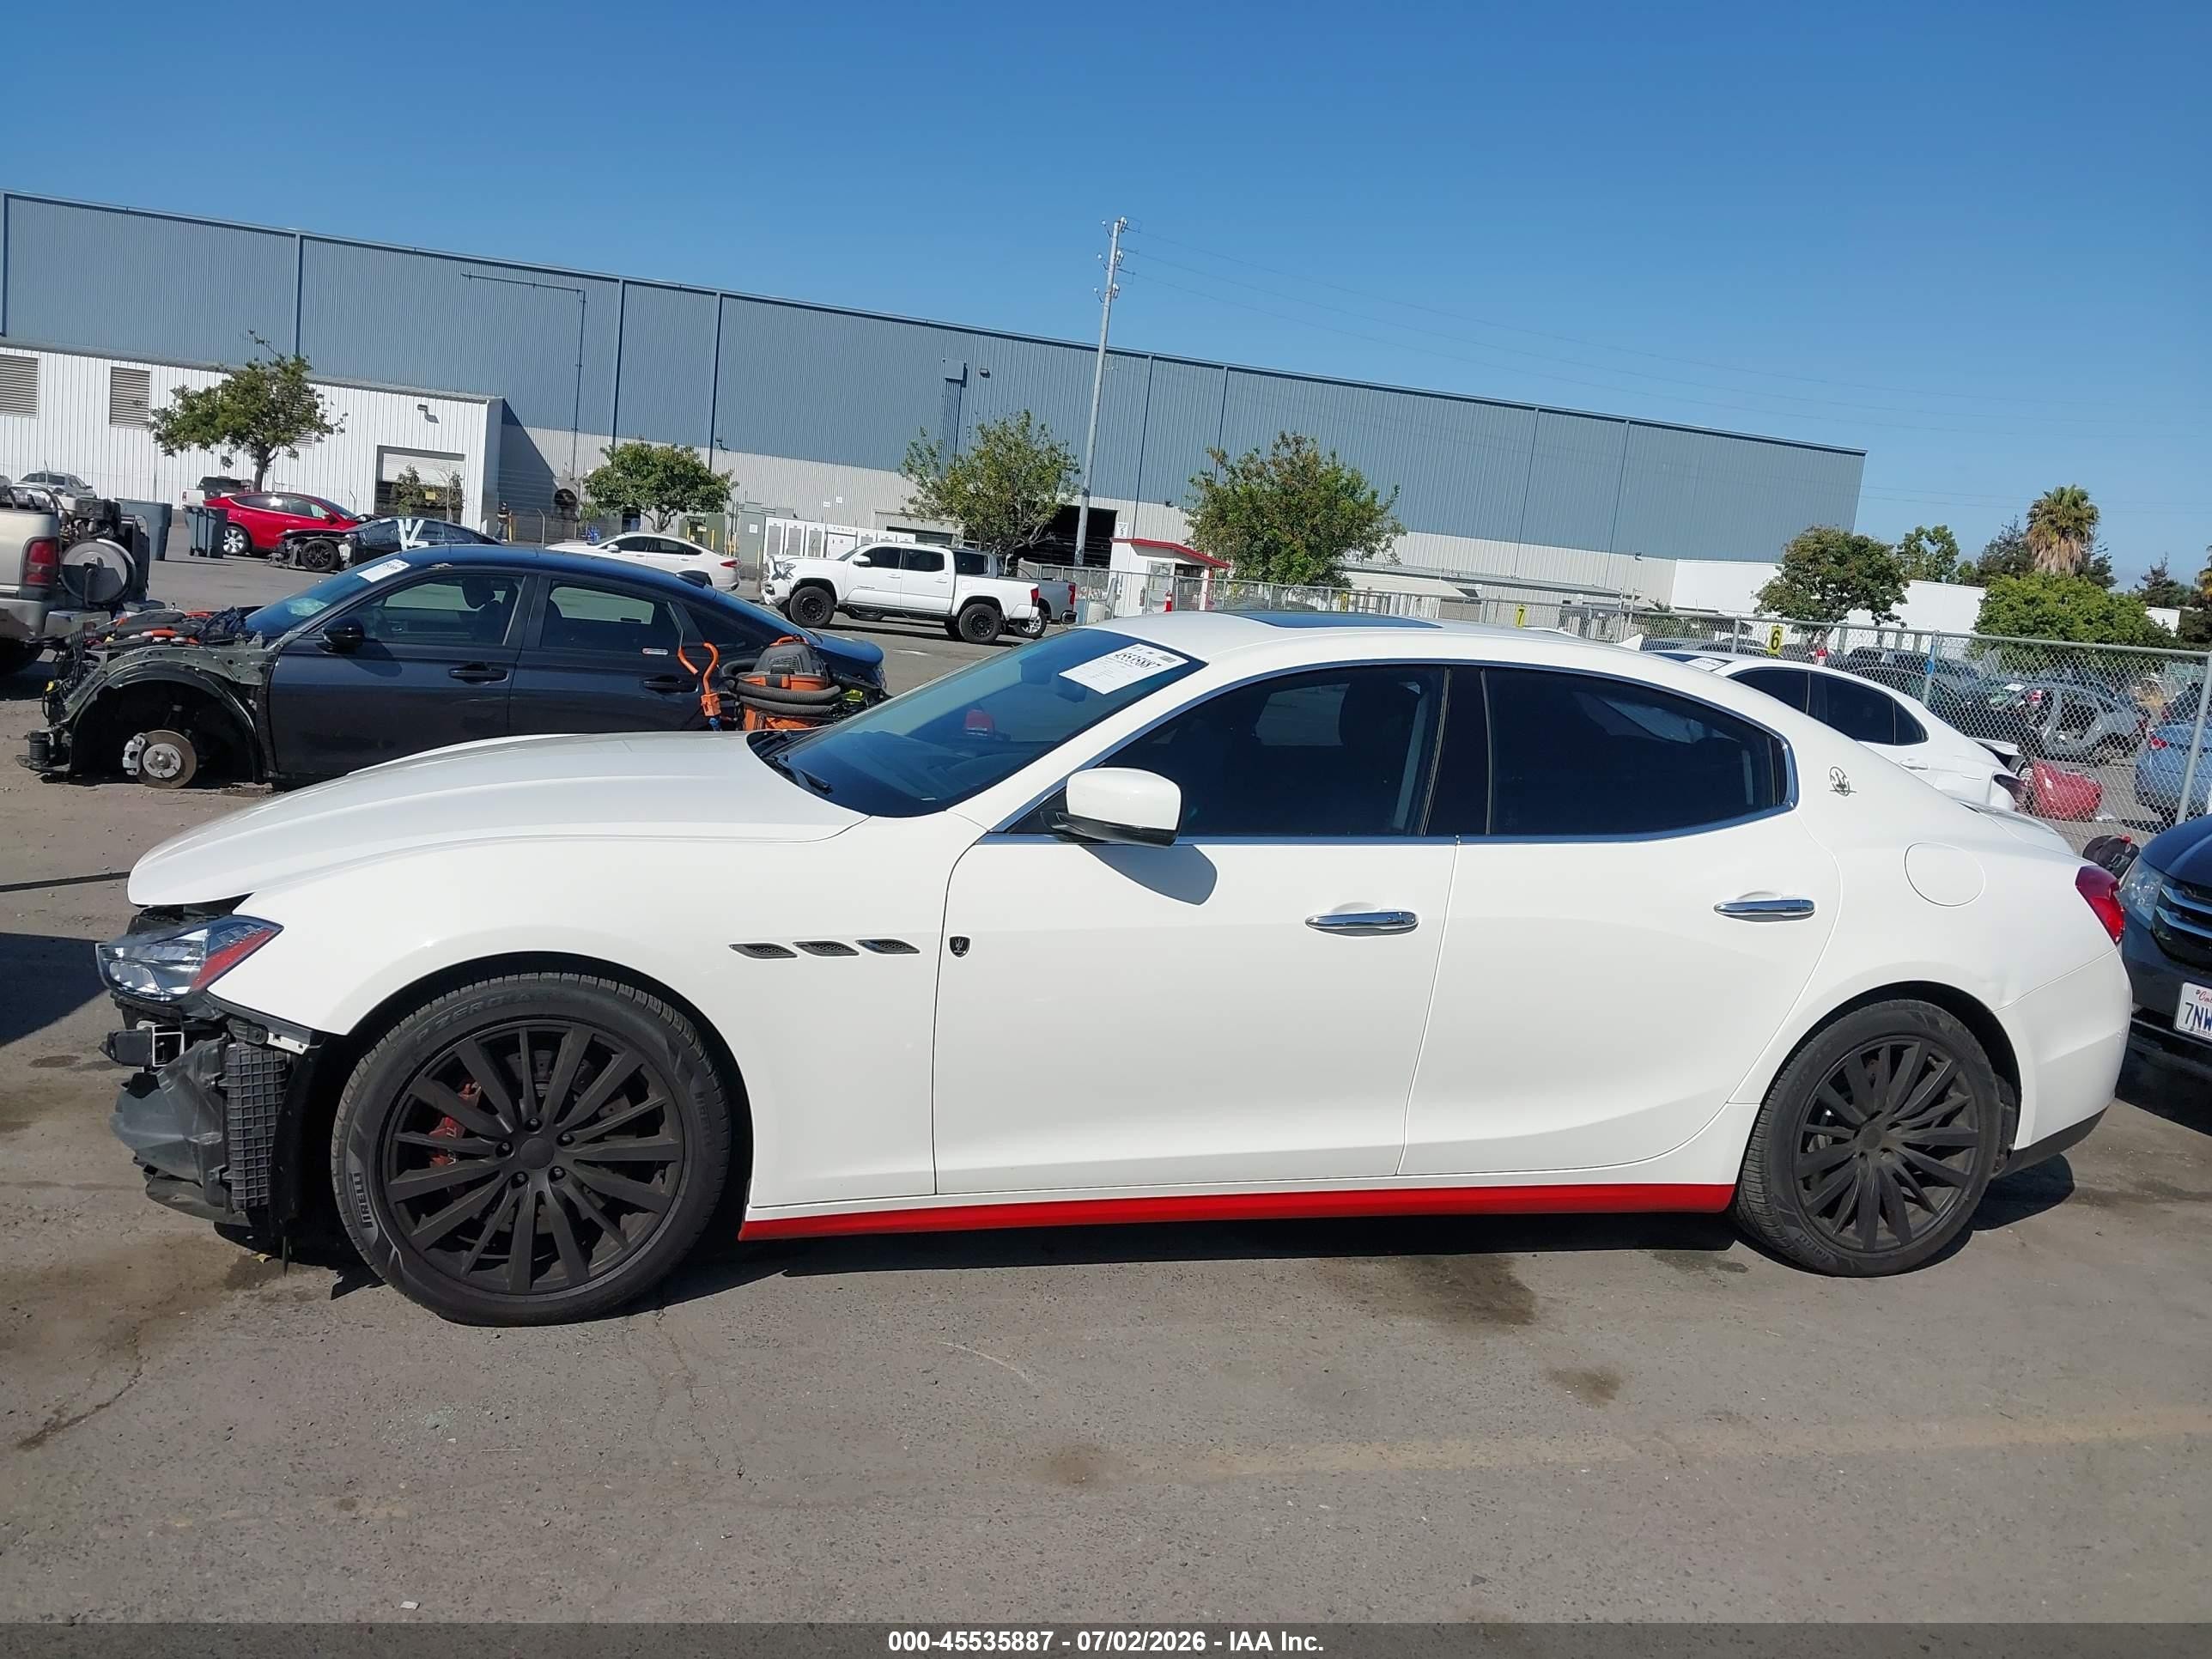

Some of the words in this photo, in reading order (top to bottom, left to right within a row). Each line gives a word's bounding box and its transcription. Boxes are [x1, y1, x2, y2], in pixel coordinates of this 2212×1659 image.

[1517, 609, 1525, 625] 7
[1771, 629, 1780, 650] 6
[350, 1172, 373, 1229] PIRELLI
